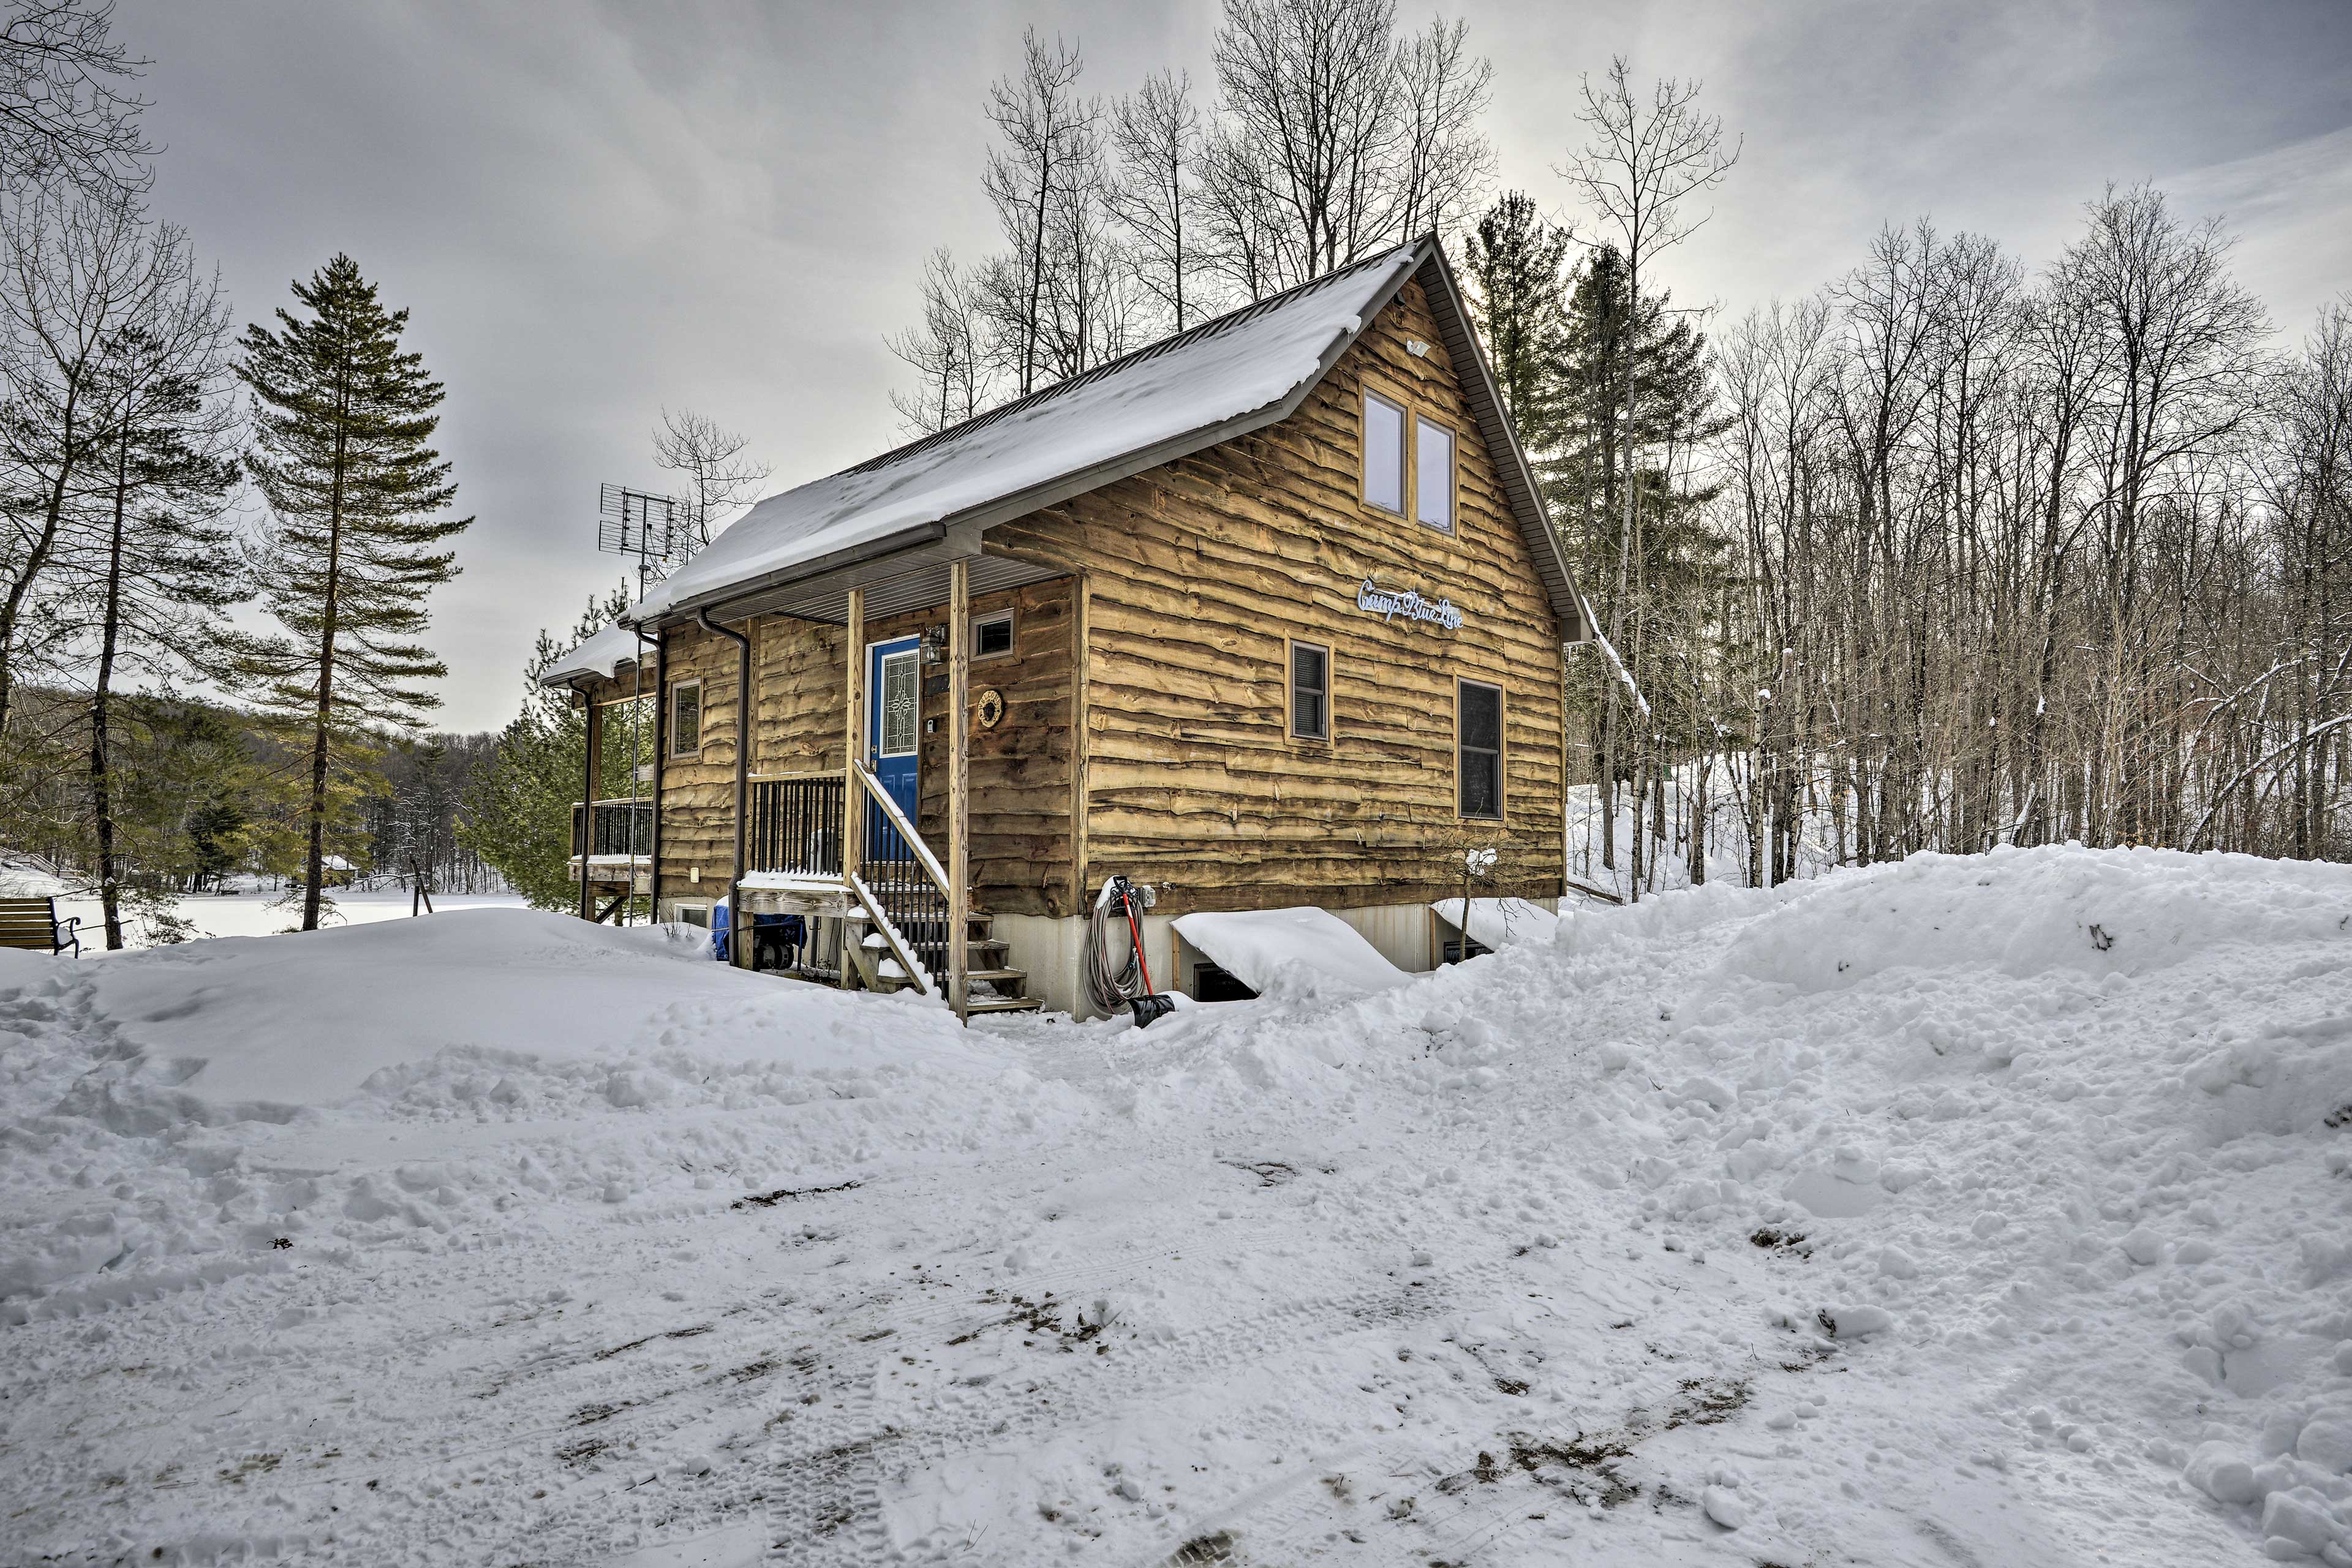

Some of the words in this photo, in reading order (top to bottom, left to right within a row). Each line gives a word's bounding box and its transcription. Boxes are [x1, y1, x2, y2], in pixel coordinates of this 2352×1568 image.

[1357, 579, 1402, 621] Camp
[1402, 590, 1438, 620] Blue
[1437, 598, 1463, 630] Line
[979, 692, 1000, 710] WELCOME
